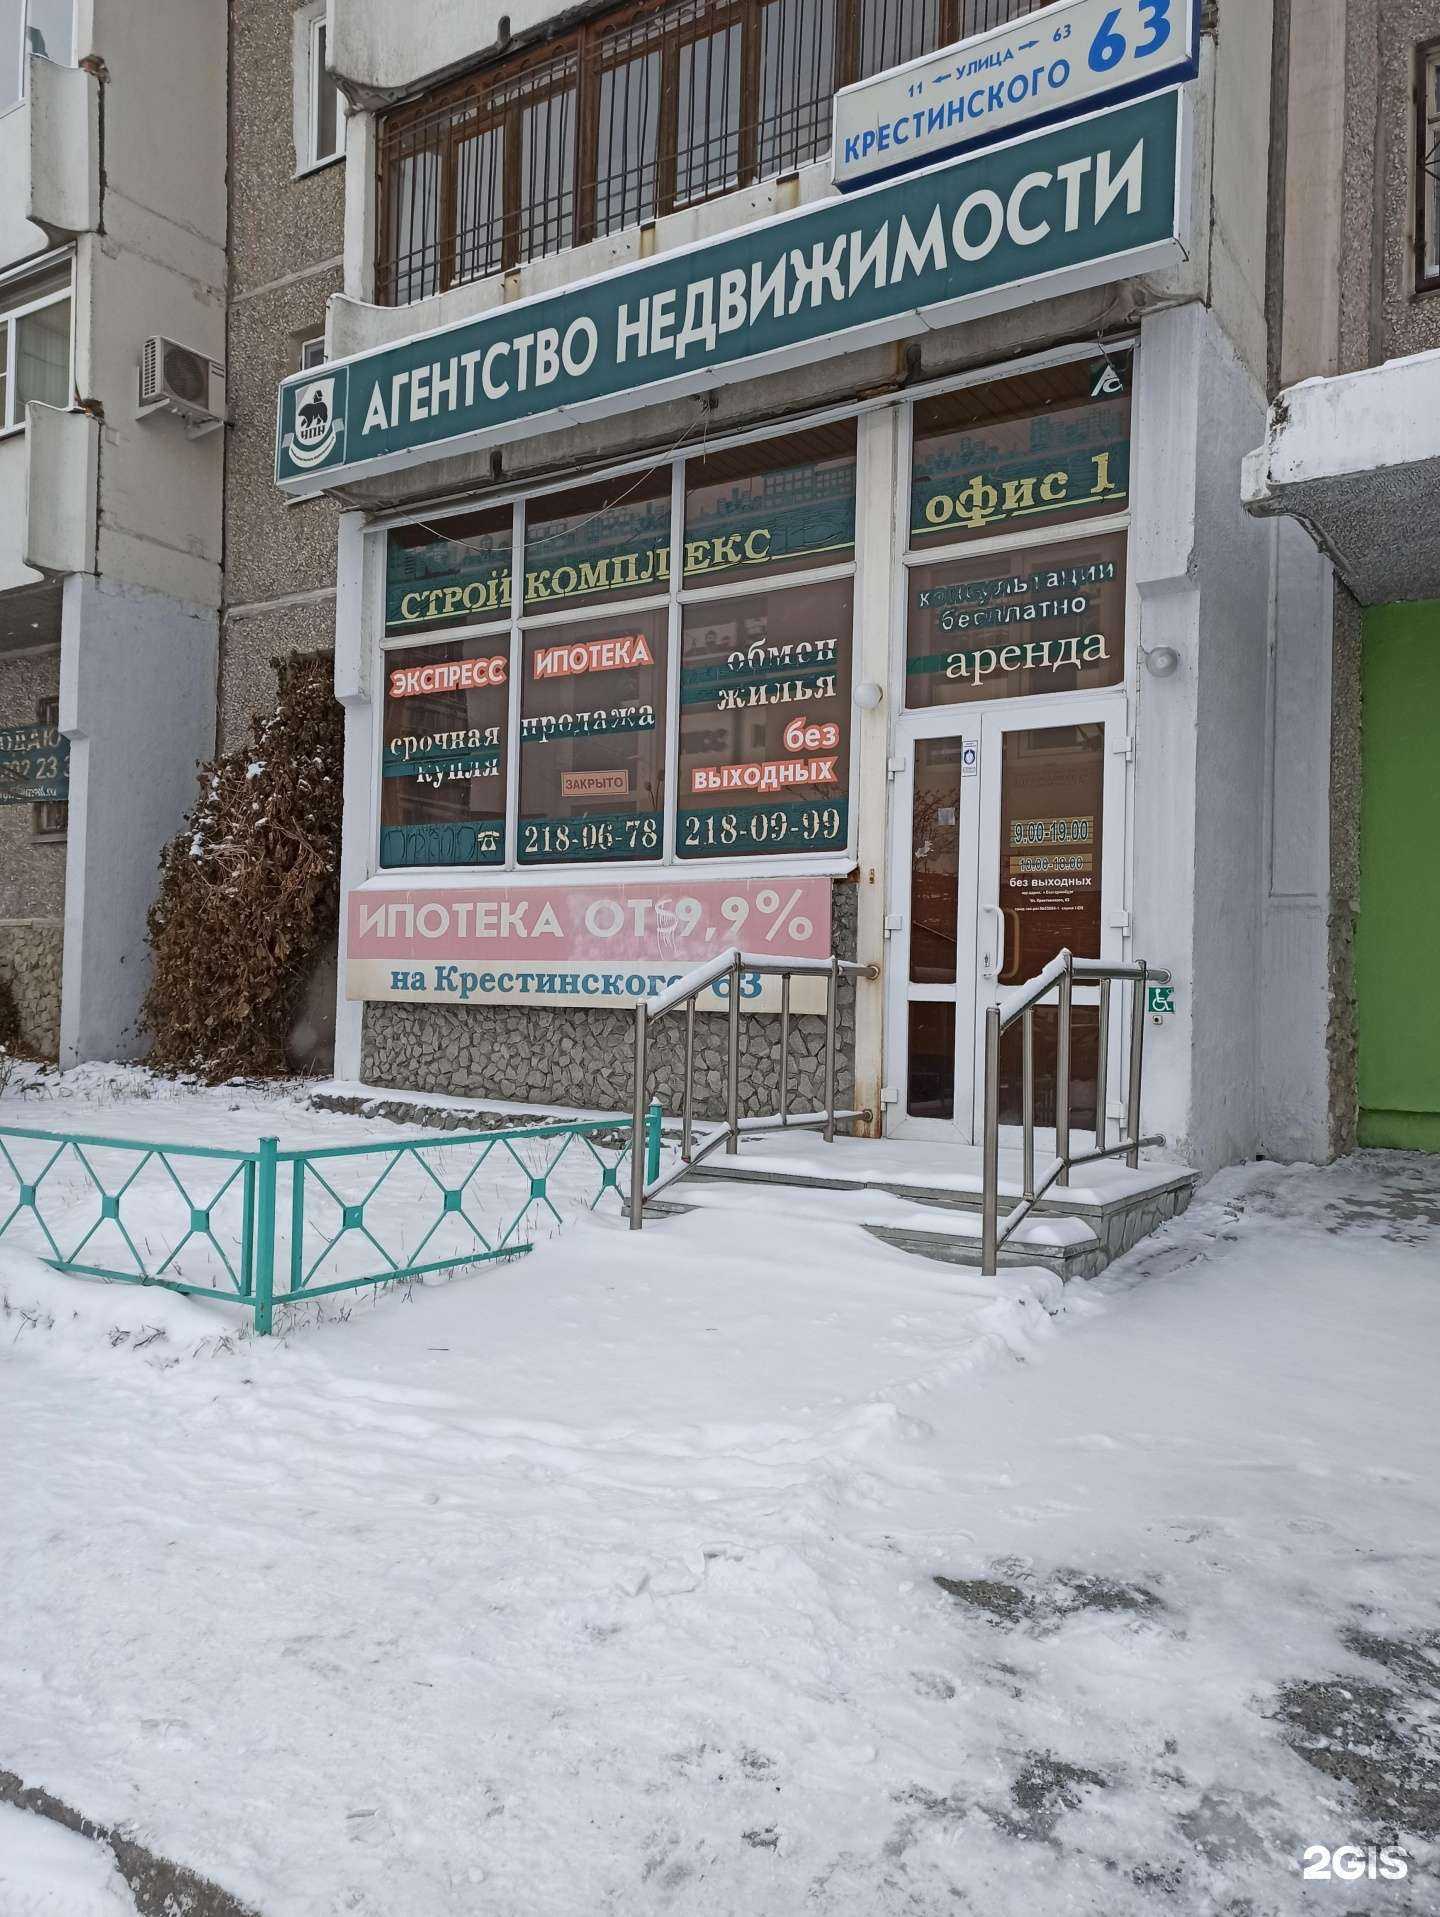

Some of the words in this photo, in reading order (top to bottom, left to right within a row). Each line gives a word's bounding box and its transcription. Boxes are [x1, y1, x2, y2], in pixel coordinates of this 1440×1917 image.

[907, 79, 923, 98] 11
[956, 46, 1014, 80] УЛИЦА
[1052, 23, 1073, 42] 63
[1087, 0, 1172, 73] 63
[844, 58, 1071, 163] КРЕСТИНСКОГО
[361, 316, 599, 436] АГЕНТСТВО
[616, 138, 1145, 365] НЕДВИЖИМОСТИ
[925, 471, 1069, 528] офис
[1090, 452, 1116, 494] 1
[391, 657, 506, 697] ЭКСПРЕСС
[535, 637, 651, 676] ИПОТЕКА
[727, 638, 838, 671] обмен
[945, 632, 1111, 687] аренда
[717, 675, 837, 711] жилья
[390, 726, 500, 761] срочная
[521, 704, 655, 743] продажа
[785, 719, 837, 750] без
[565, 776, 624, 790] ЗАКРЫТО
[524, 819, 658, 853] 218-06-78
[685, 808, 840, 846] 218-09-99
[1009, 877, 1029, 887] без
[1031, 877, 1092, 887] выходных
[359, 900, 564, 939] ИПОТЕКА
[584, 898, 654, 938] ОТ
[390, 967, 431, 992] на
